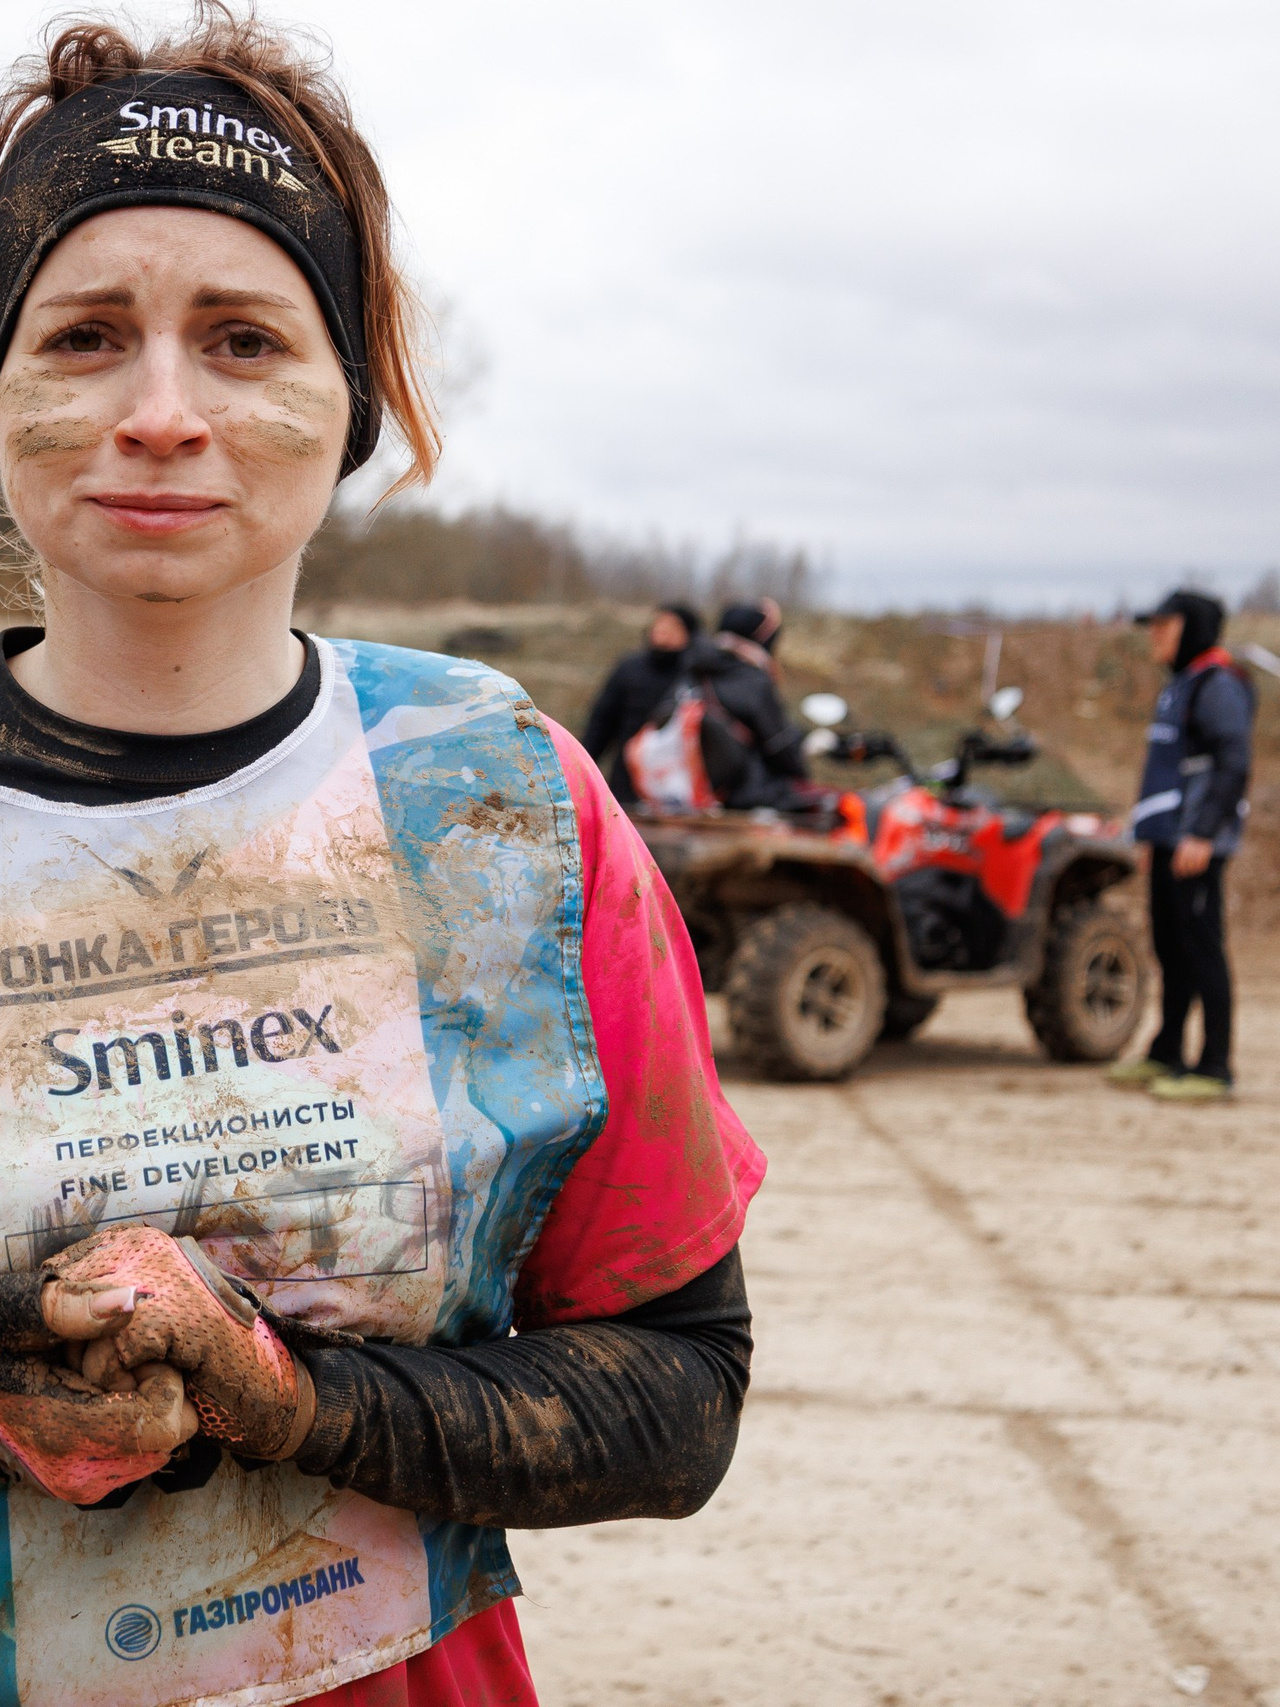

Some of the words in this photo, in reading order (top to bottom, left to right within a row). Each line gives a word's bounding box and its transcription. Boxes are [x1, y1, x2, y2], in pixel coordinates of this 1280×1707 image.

[120, 101, 291, 166] Sminex
[147, 129, 269, 181] team
[42, 1004, 341, 1096] Sminex
[55, 1099, 355, 1161] ПЕРФЕКЦИОНИСТЫ
[61, 1171, 128, 1200] FINE
[143, 1139, 358, 1187] DEVELOPMENT
[173, 1556, 365, 1638] ГАЗПРОМБАНК
